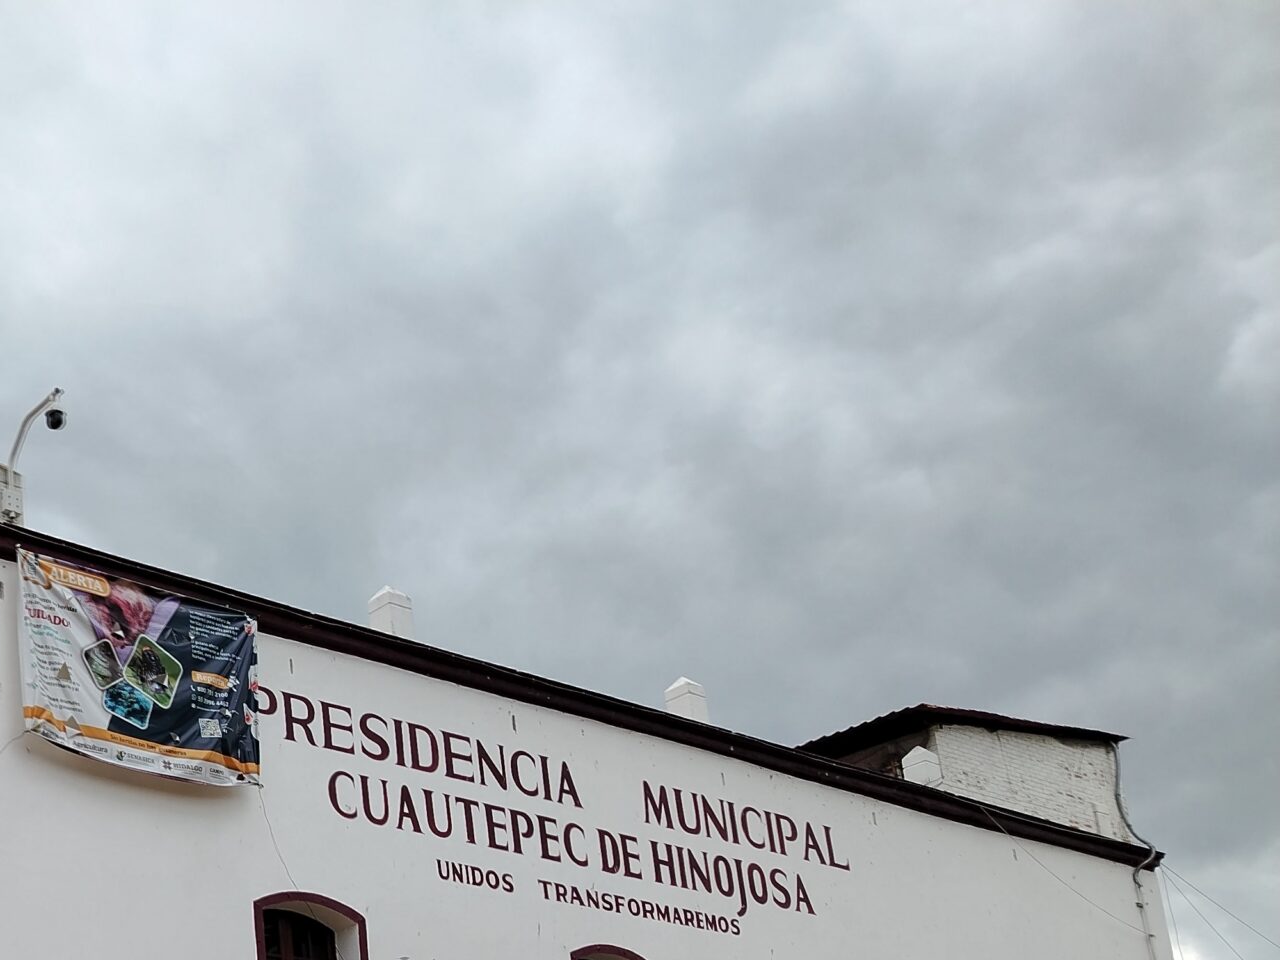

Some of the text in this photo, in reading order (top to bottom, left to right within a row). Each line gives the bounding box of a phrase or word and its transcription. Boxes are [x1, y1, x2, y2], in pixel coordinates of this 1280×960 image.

[50, 566, 105, 593] ALERTA
[173, 762, 203, 773] HIDALGO
[257, 685, 851, 872] PRESIDENCIA MUNICIPAL
[328, 770, 817, 916] CUAUTEPEC DE HINOJOSA
[436, 859, 741, 936] UNIDOS TRANSFORMAREMOS
